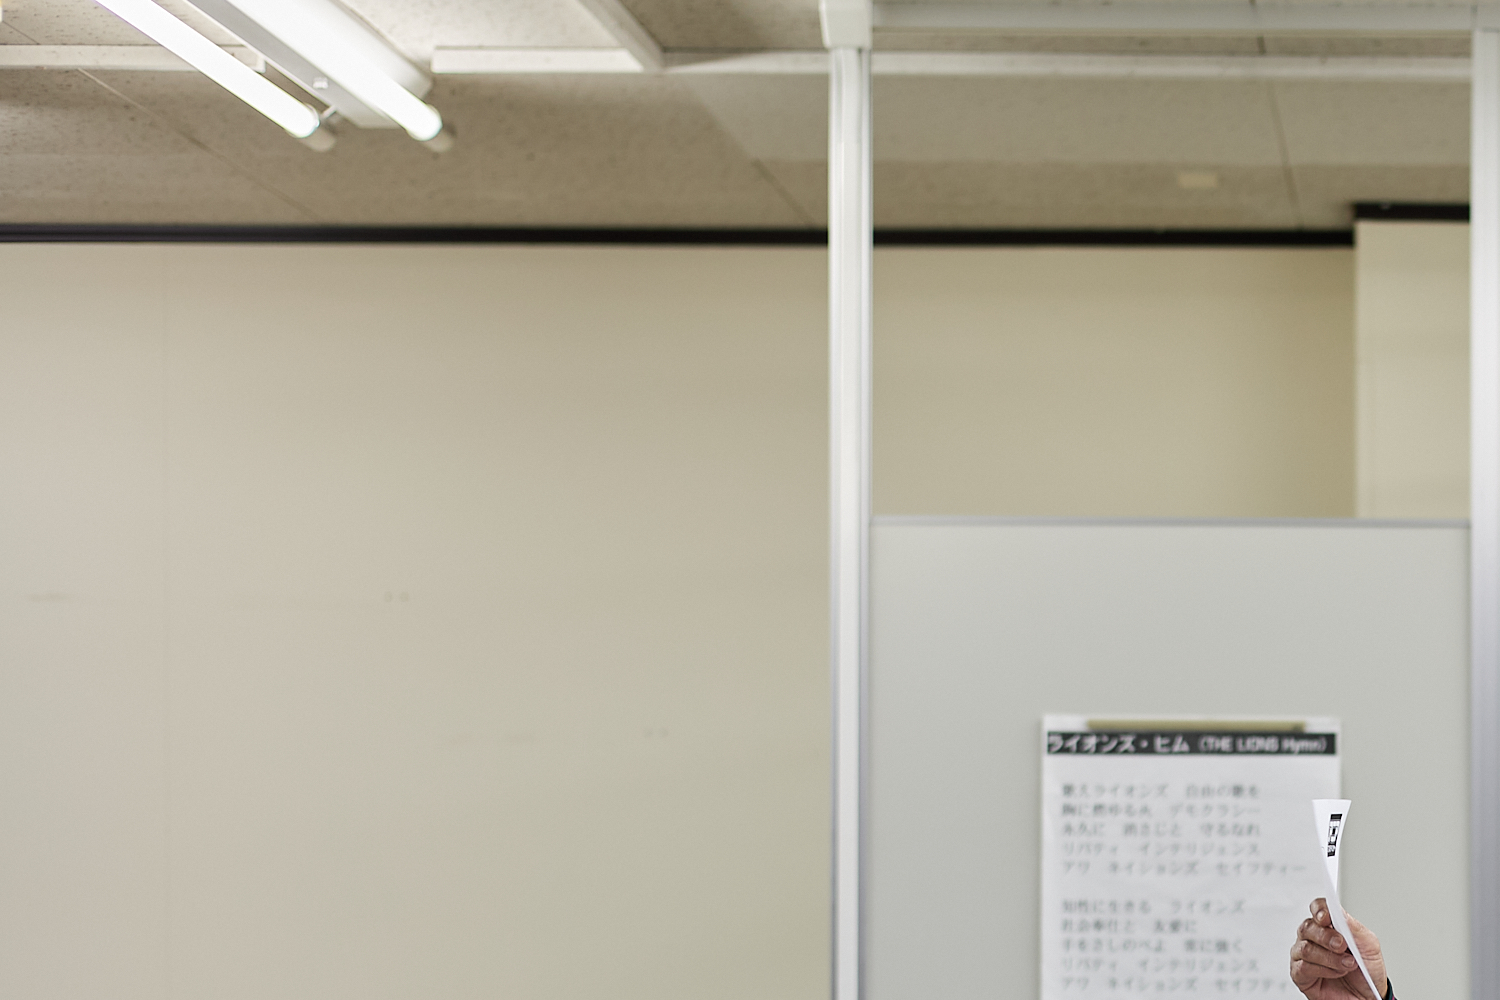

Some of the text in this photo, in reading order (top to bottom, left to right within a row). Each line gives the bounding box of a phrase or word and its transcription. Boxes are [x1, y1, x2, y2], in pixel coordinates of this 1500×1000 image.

[1048, 735, 1189, 753] ライオンズ・ヒム
[1237, 735, 1277, 752] LIONS
